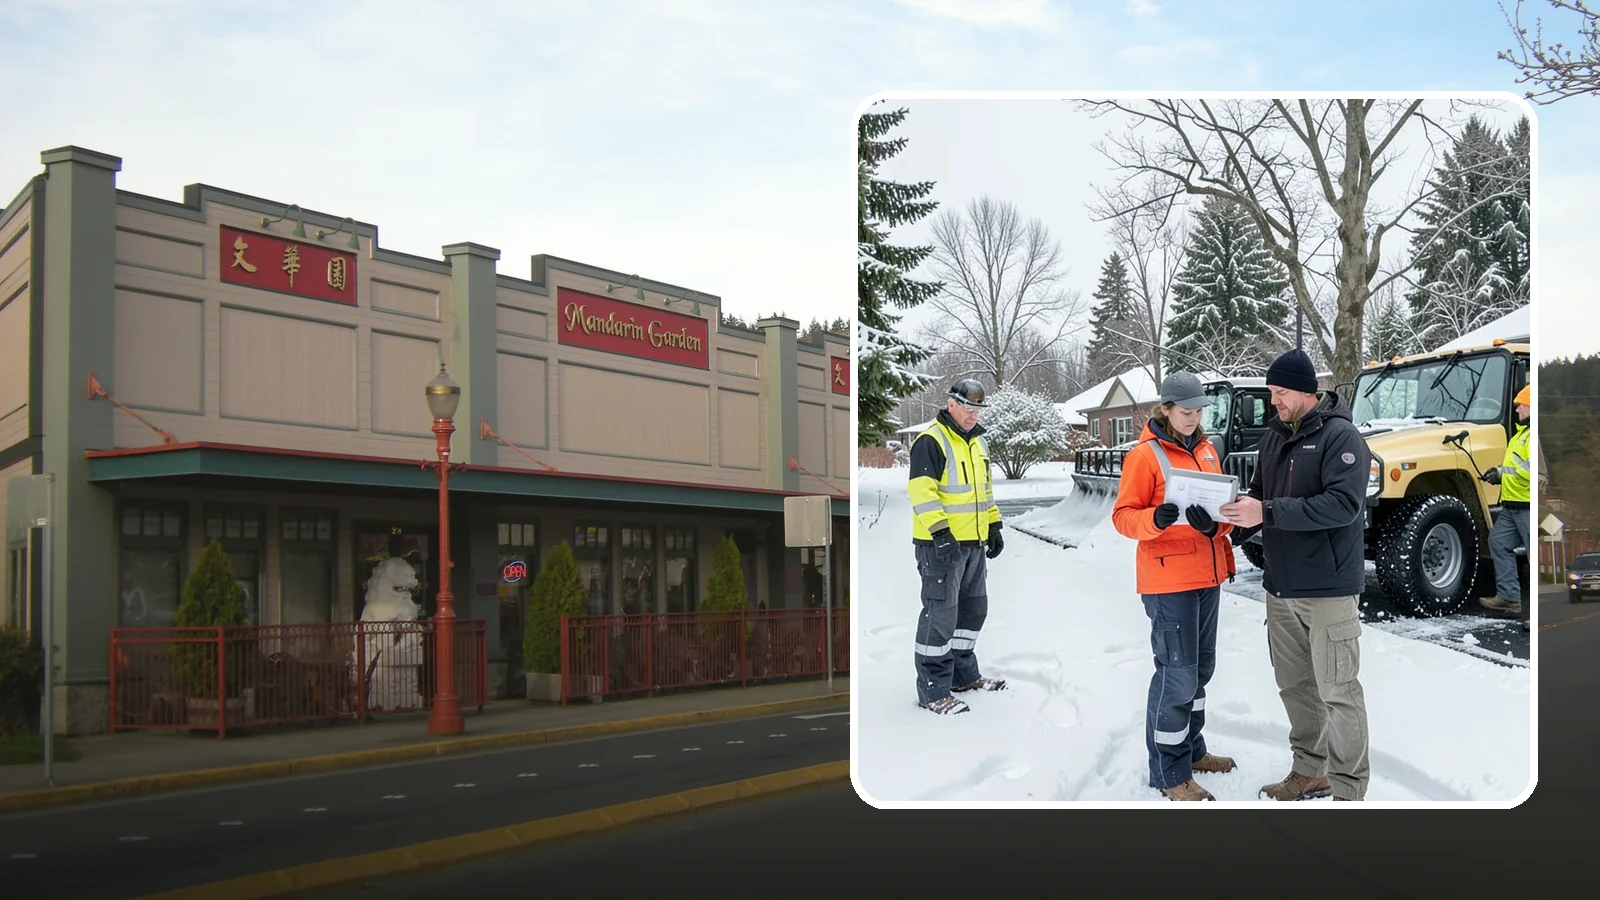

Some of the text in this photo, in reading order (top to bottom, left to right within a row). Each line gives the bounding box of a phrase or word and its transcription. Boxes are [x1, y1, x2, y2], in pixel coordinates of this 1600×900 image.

[230, 235, 346, 290] 文華園
[564, 302, 702, 352] Mandarin Garden
[834, 362, 847, 386] 文
[503, 565, 527, 578] OPEN
